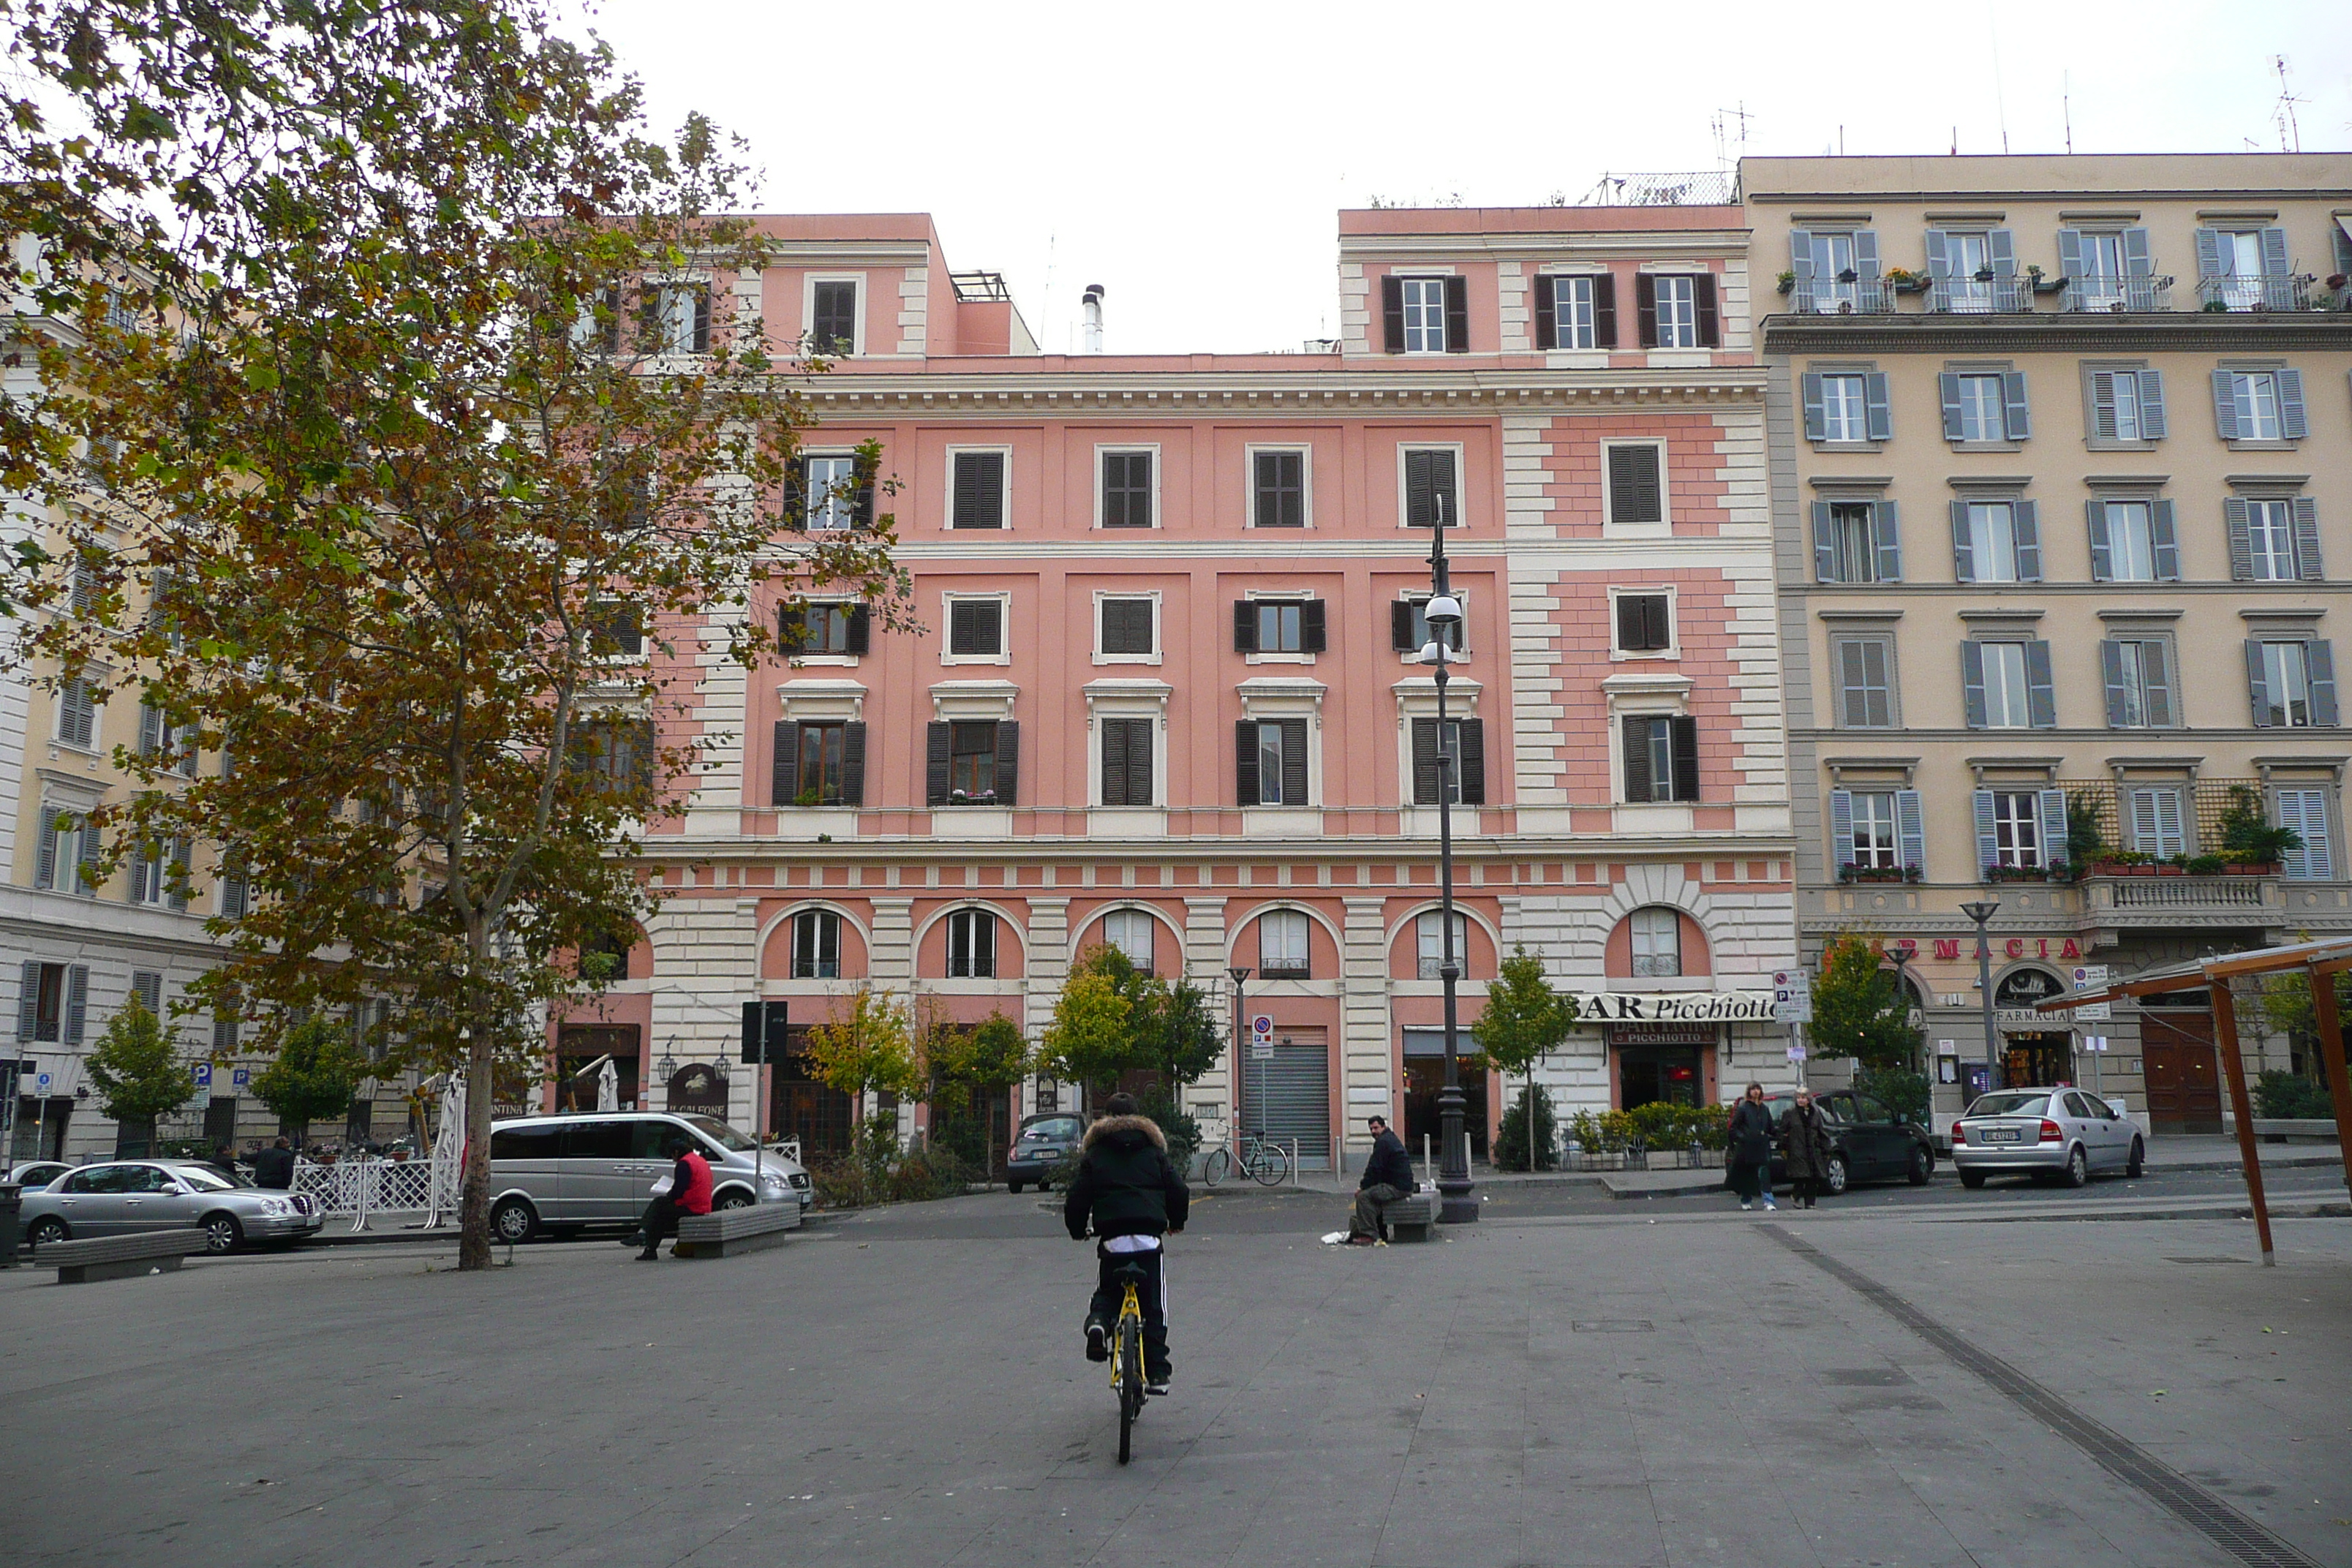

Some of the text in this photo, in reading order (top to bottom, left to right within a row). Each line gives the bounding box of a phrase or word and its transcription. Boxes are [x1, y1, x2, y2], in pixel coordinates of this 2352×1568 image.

[1996, 1010, 2066, 1021] FARMACIA
[1628, 1033, 1700, 1042] PICCHIOTTO
[237, 1072, 246, 1082] P
